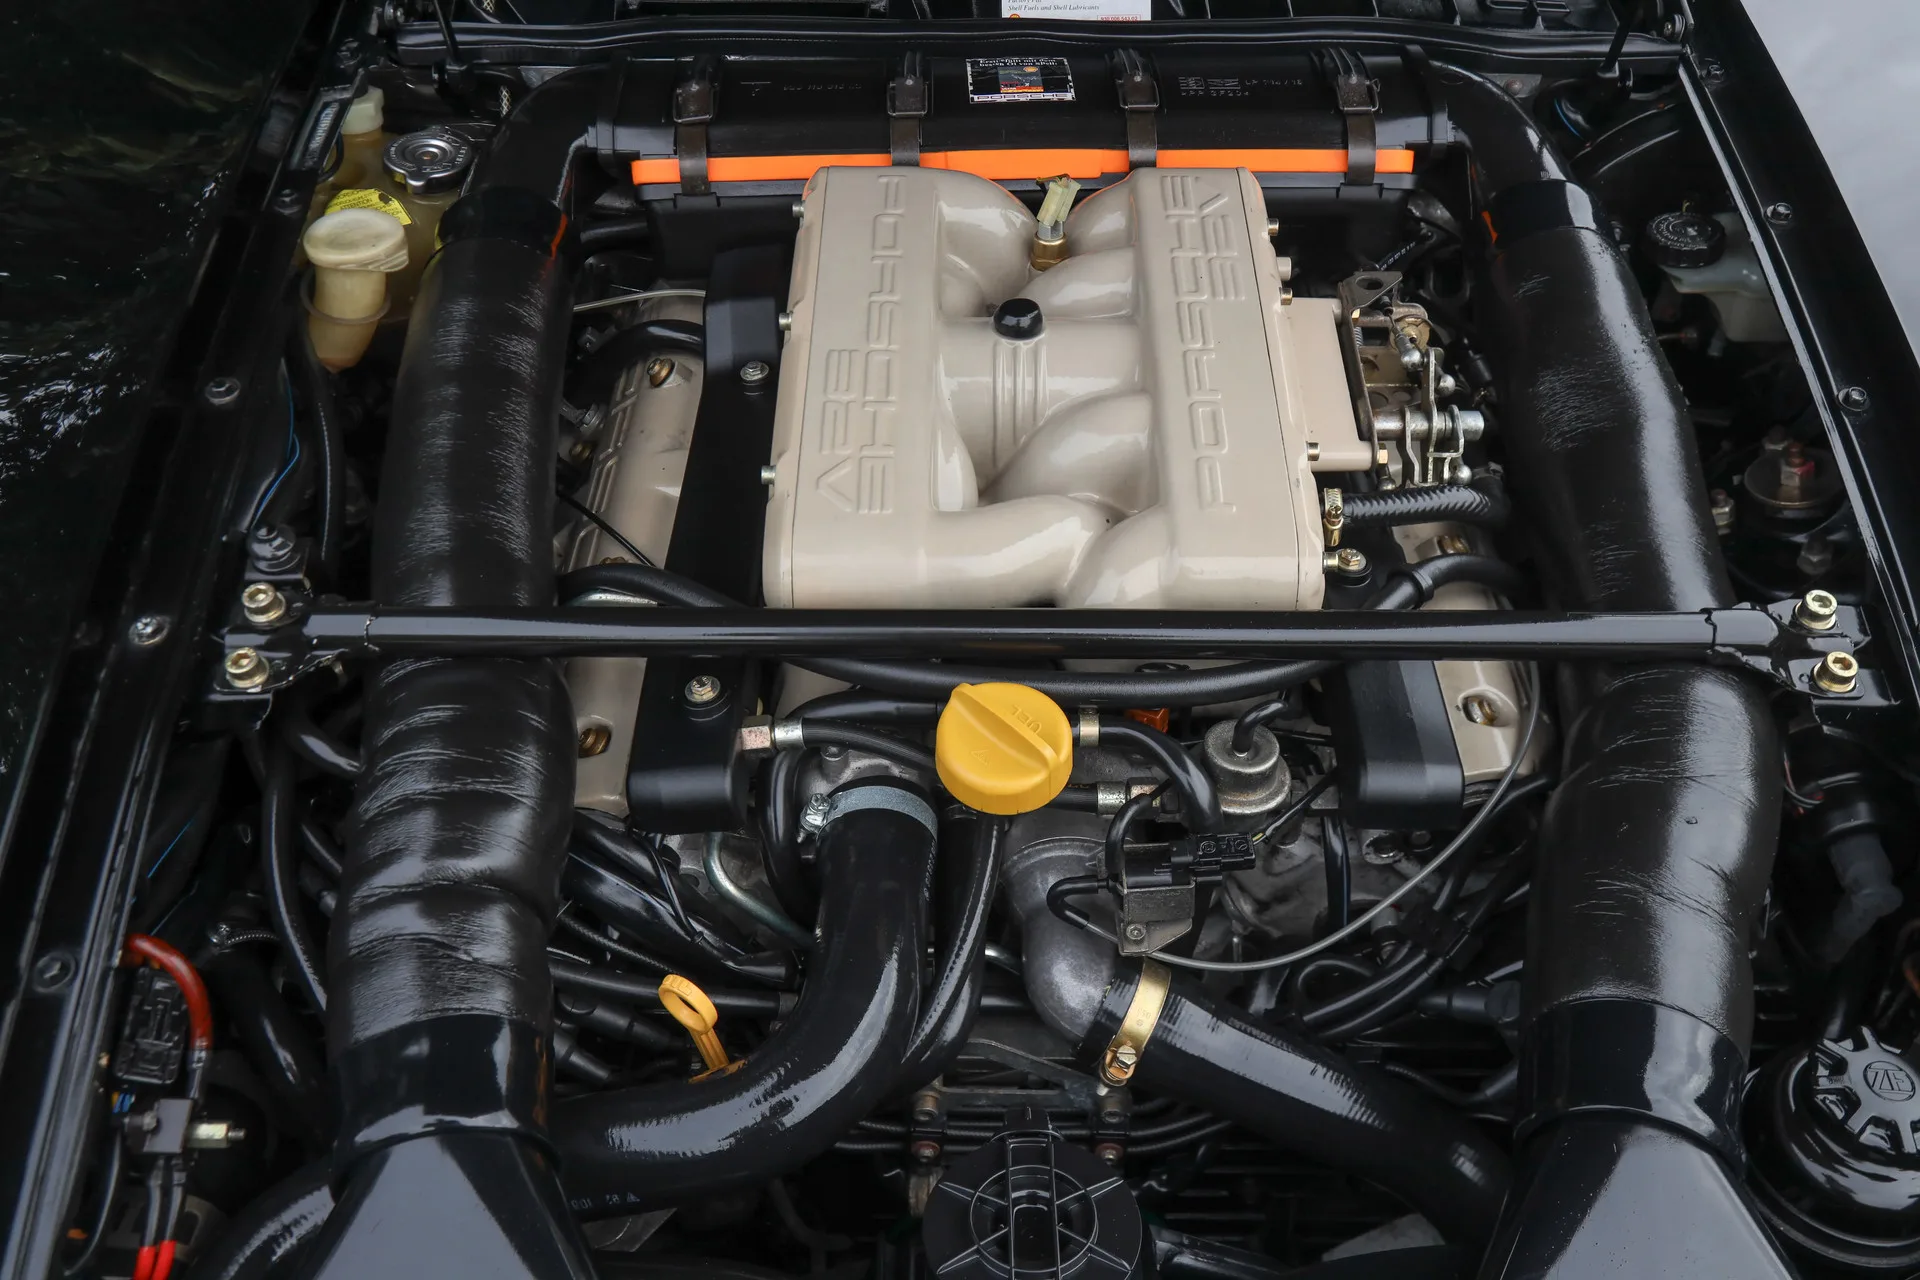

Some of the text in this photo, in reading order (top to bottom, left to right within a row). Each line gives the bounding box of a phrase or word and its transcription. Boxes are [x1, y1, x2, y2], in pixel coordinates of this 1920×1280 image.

[816, 349, 859, 513] 32V
[857, 174, 907, 514] PORSCHE
[1160, 175, 1237, 513] PORSCHE
